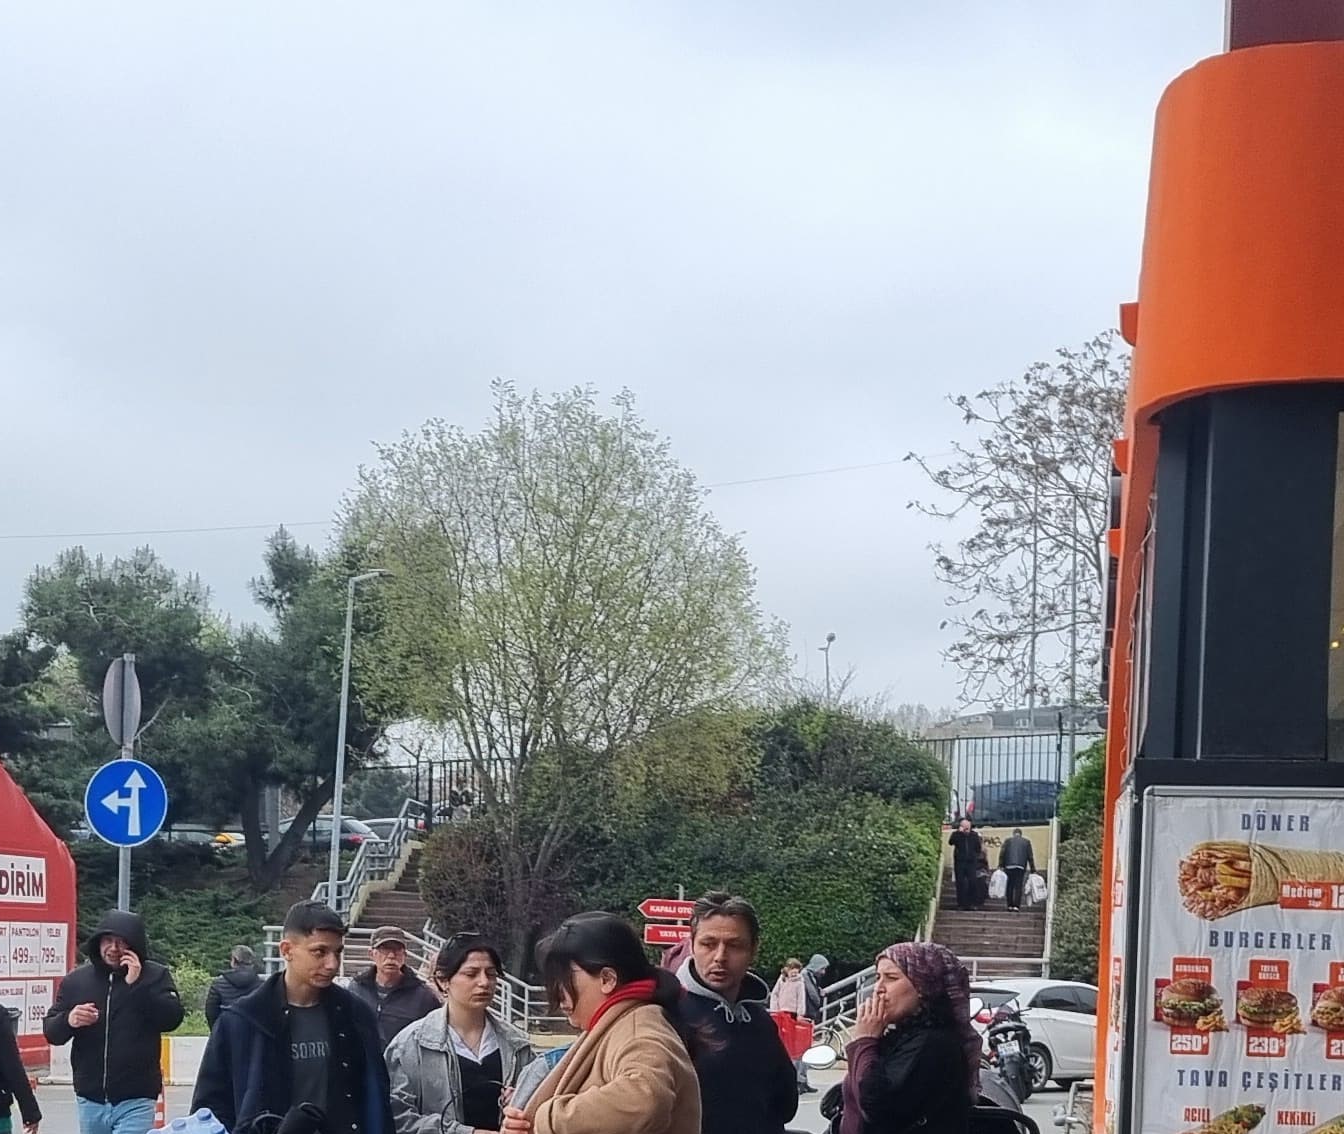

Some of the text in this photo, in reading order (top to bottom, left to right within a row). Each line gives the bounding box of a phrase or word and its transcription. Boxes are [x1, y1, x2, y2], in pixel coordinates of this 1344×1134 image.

[1241, 809, 1310, 831] DÖNER
[1209, 930, 1332, 951] BURGERLER
[1177, 1069, 1228, 1087] TAVA
